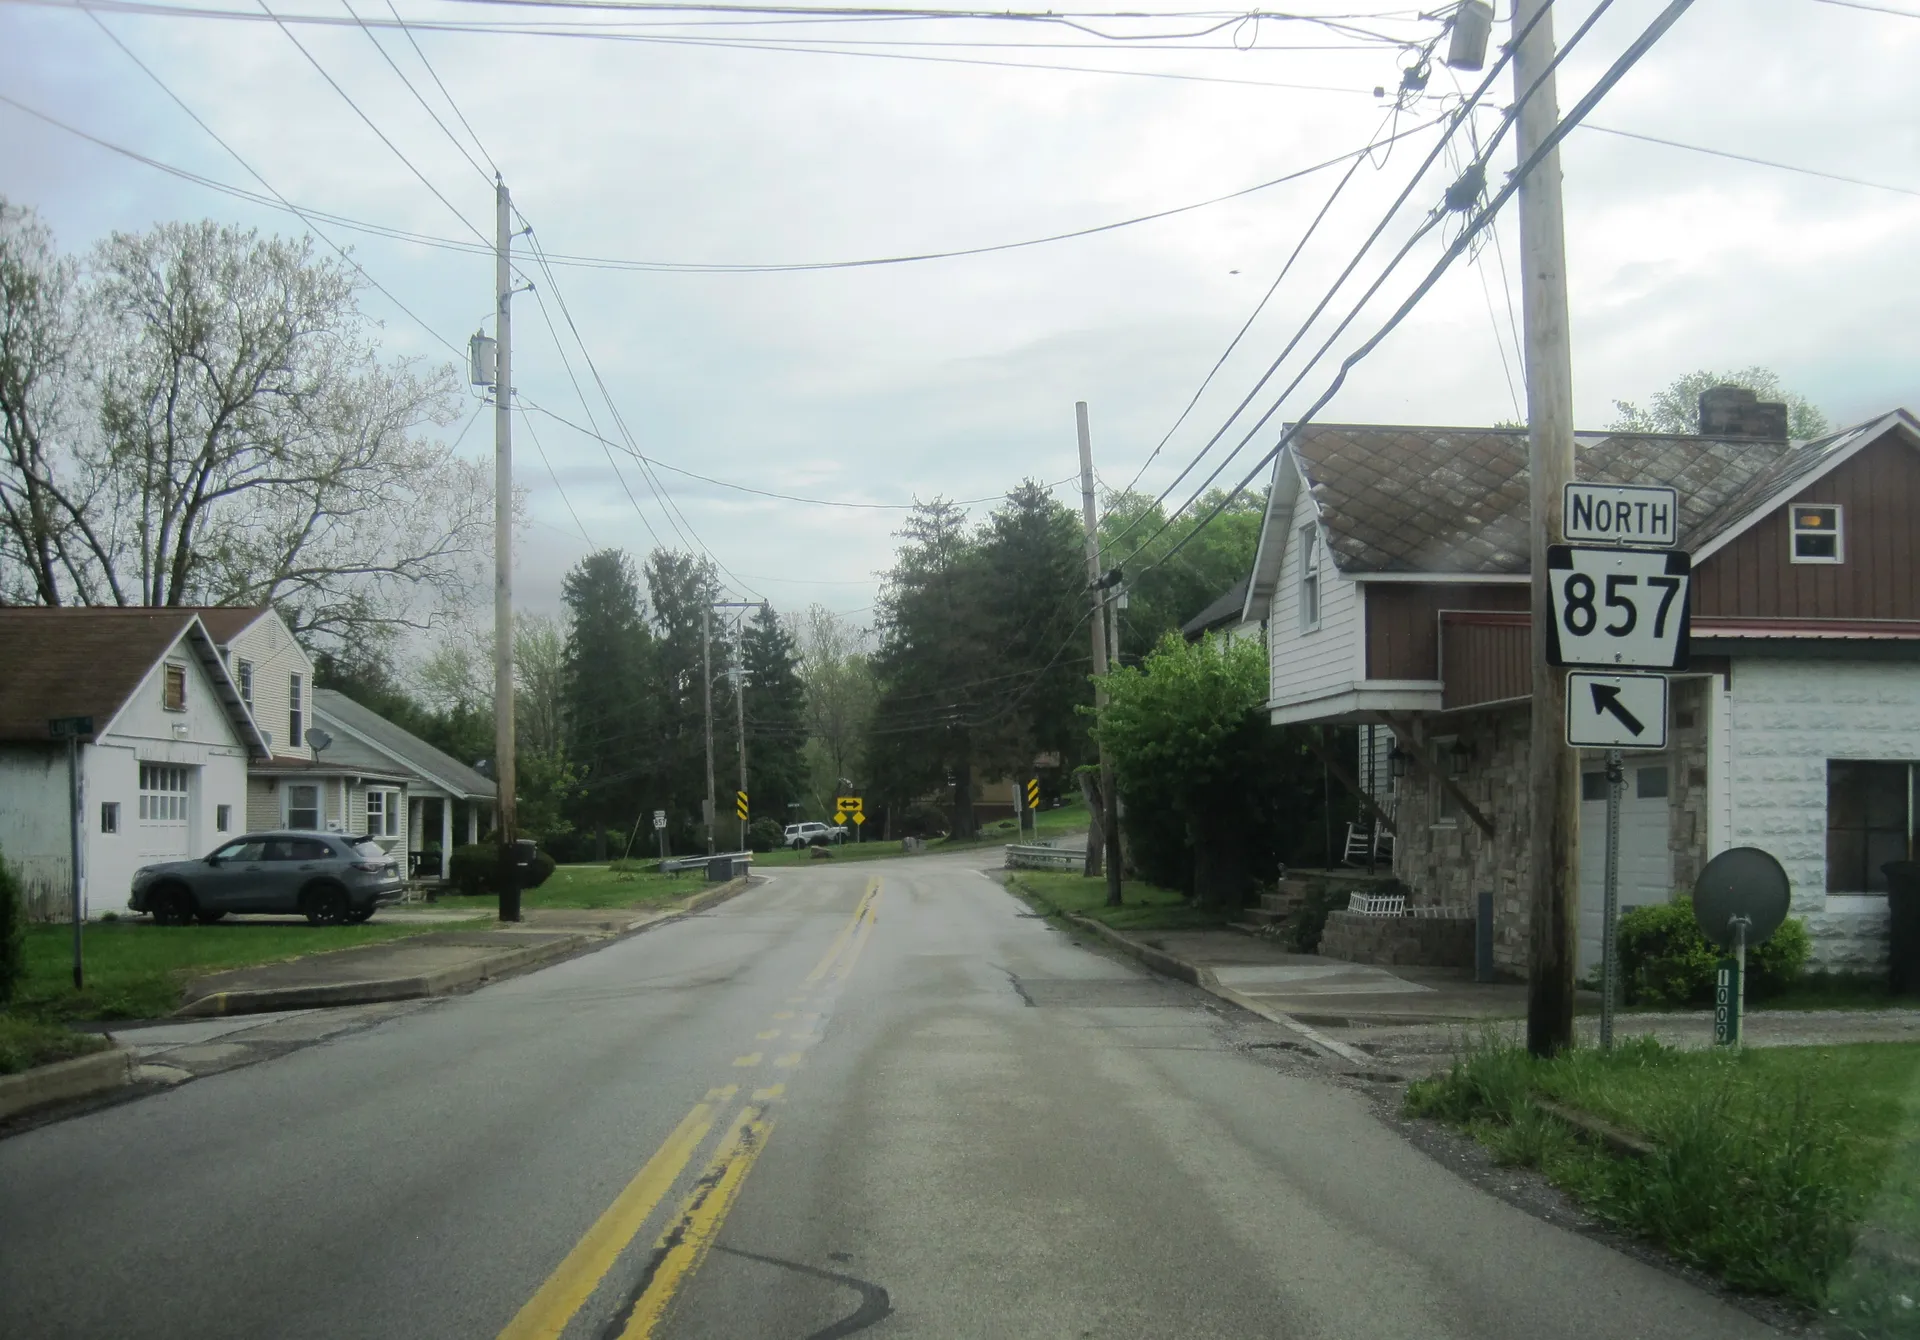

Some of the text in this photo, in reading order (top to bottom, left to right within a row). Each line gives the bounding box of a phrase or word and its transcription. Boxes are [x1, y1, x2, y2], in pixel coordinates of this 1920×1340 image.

[1572, 493, 1668, 535] NORTH
[1563, 572, 1681, 638] 857
[1716, 969, 1729, 1041] 1009
